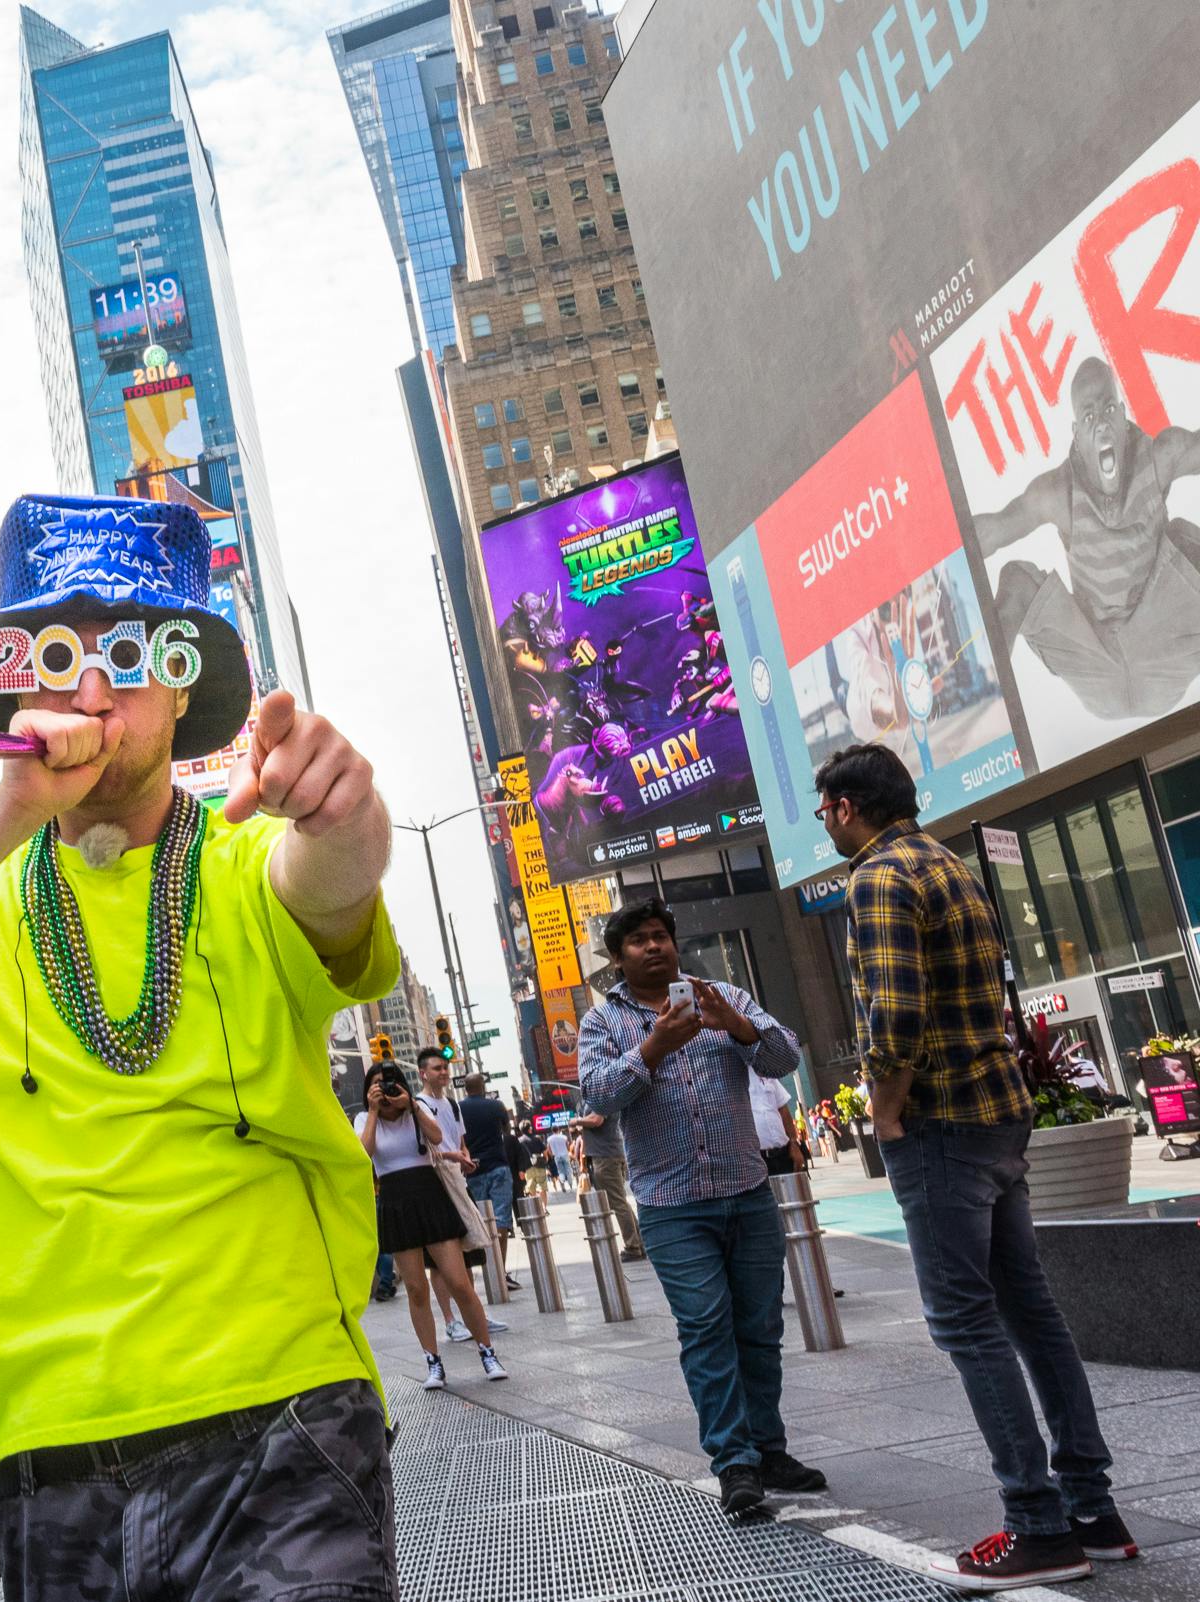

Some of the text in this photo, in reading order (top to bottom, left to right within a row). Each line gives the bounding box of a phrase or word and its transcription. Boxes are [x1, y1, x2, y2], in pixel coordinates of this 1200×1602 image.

[717, 26, 756, 154] IF
[747, 0, 989, 282] YOU NEED
[95, 277, 178, 318] 11:39
[914, 258, 975, 329] MARRIOTT
[920, 287, 974, 349] MARQUIS
[133, 361, 178, 386] 2016
[944, 280, 1077, 478] THE
[124, 376, 192, 399] TOSHIBA
[68, 528, 138, 549] HAPPY
[559, 523, 609, 548] nickelodeon
[560, 506, 677, 556] TEENAGE MUTANT NINJA
[563, 516, 682, 577] TURTLES
[52, 546, 155, 577] NEW YEAR
[581, 545, 673, 593] LEGENDS
[629, 727, 701, 787] PLAY
[639, 756, 716, 806] FOR FREE!
[607, 839, 630, 849] Download
[637, 835, 646, 843] the
[677, 823, 712, 840] amazon
[524, 849, 544, 861] THE
[608, 842, 648, 860] App Store
[534, 909, 561, 919] TICKETS
[547, 917, 560, 925] THE
[533, 923, 568, 934] MINSKOFF
[537, 931, 566, 941] THEATRE
[543, 946, 566, 955] OFFICE
